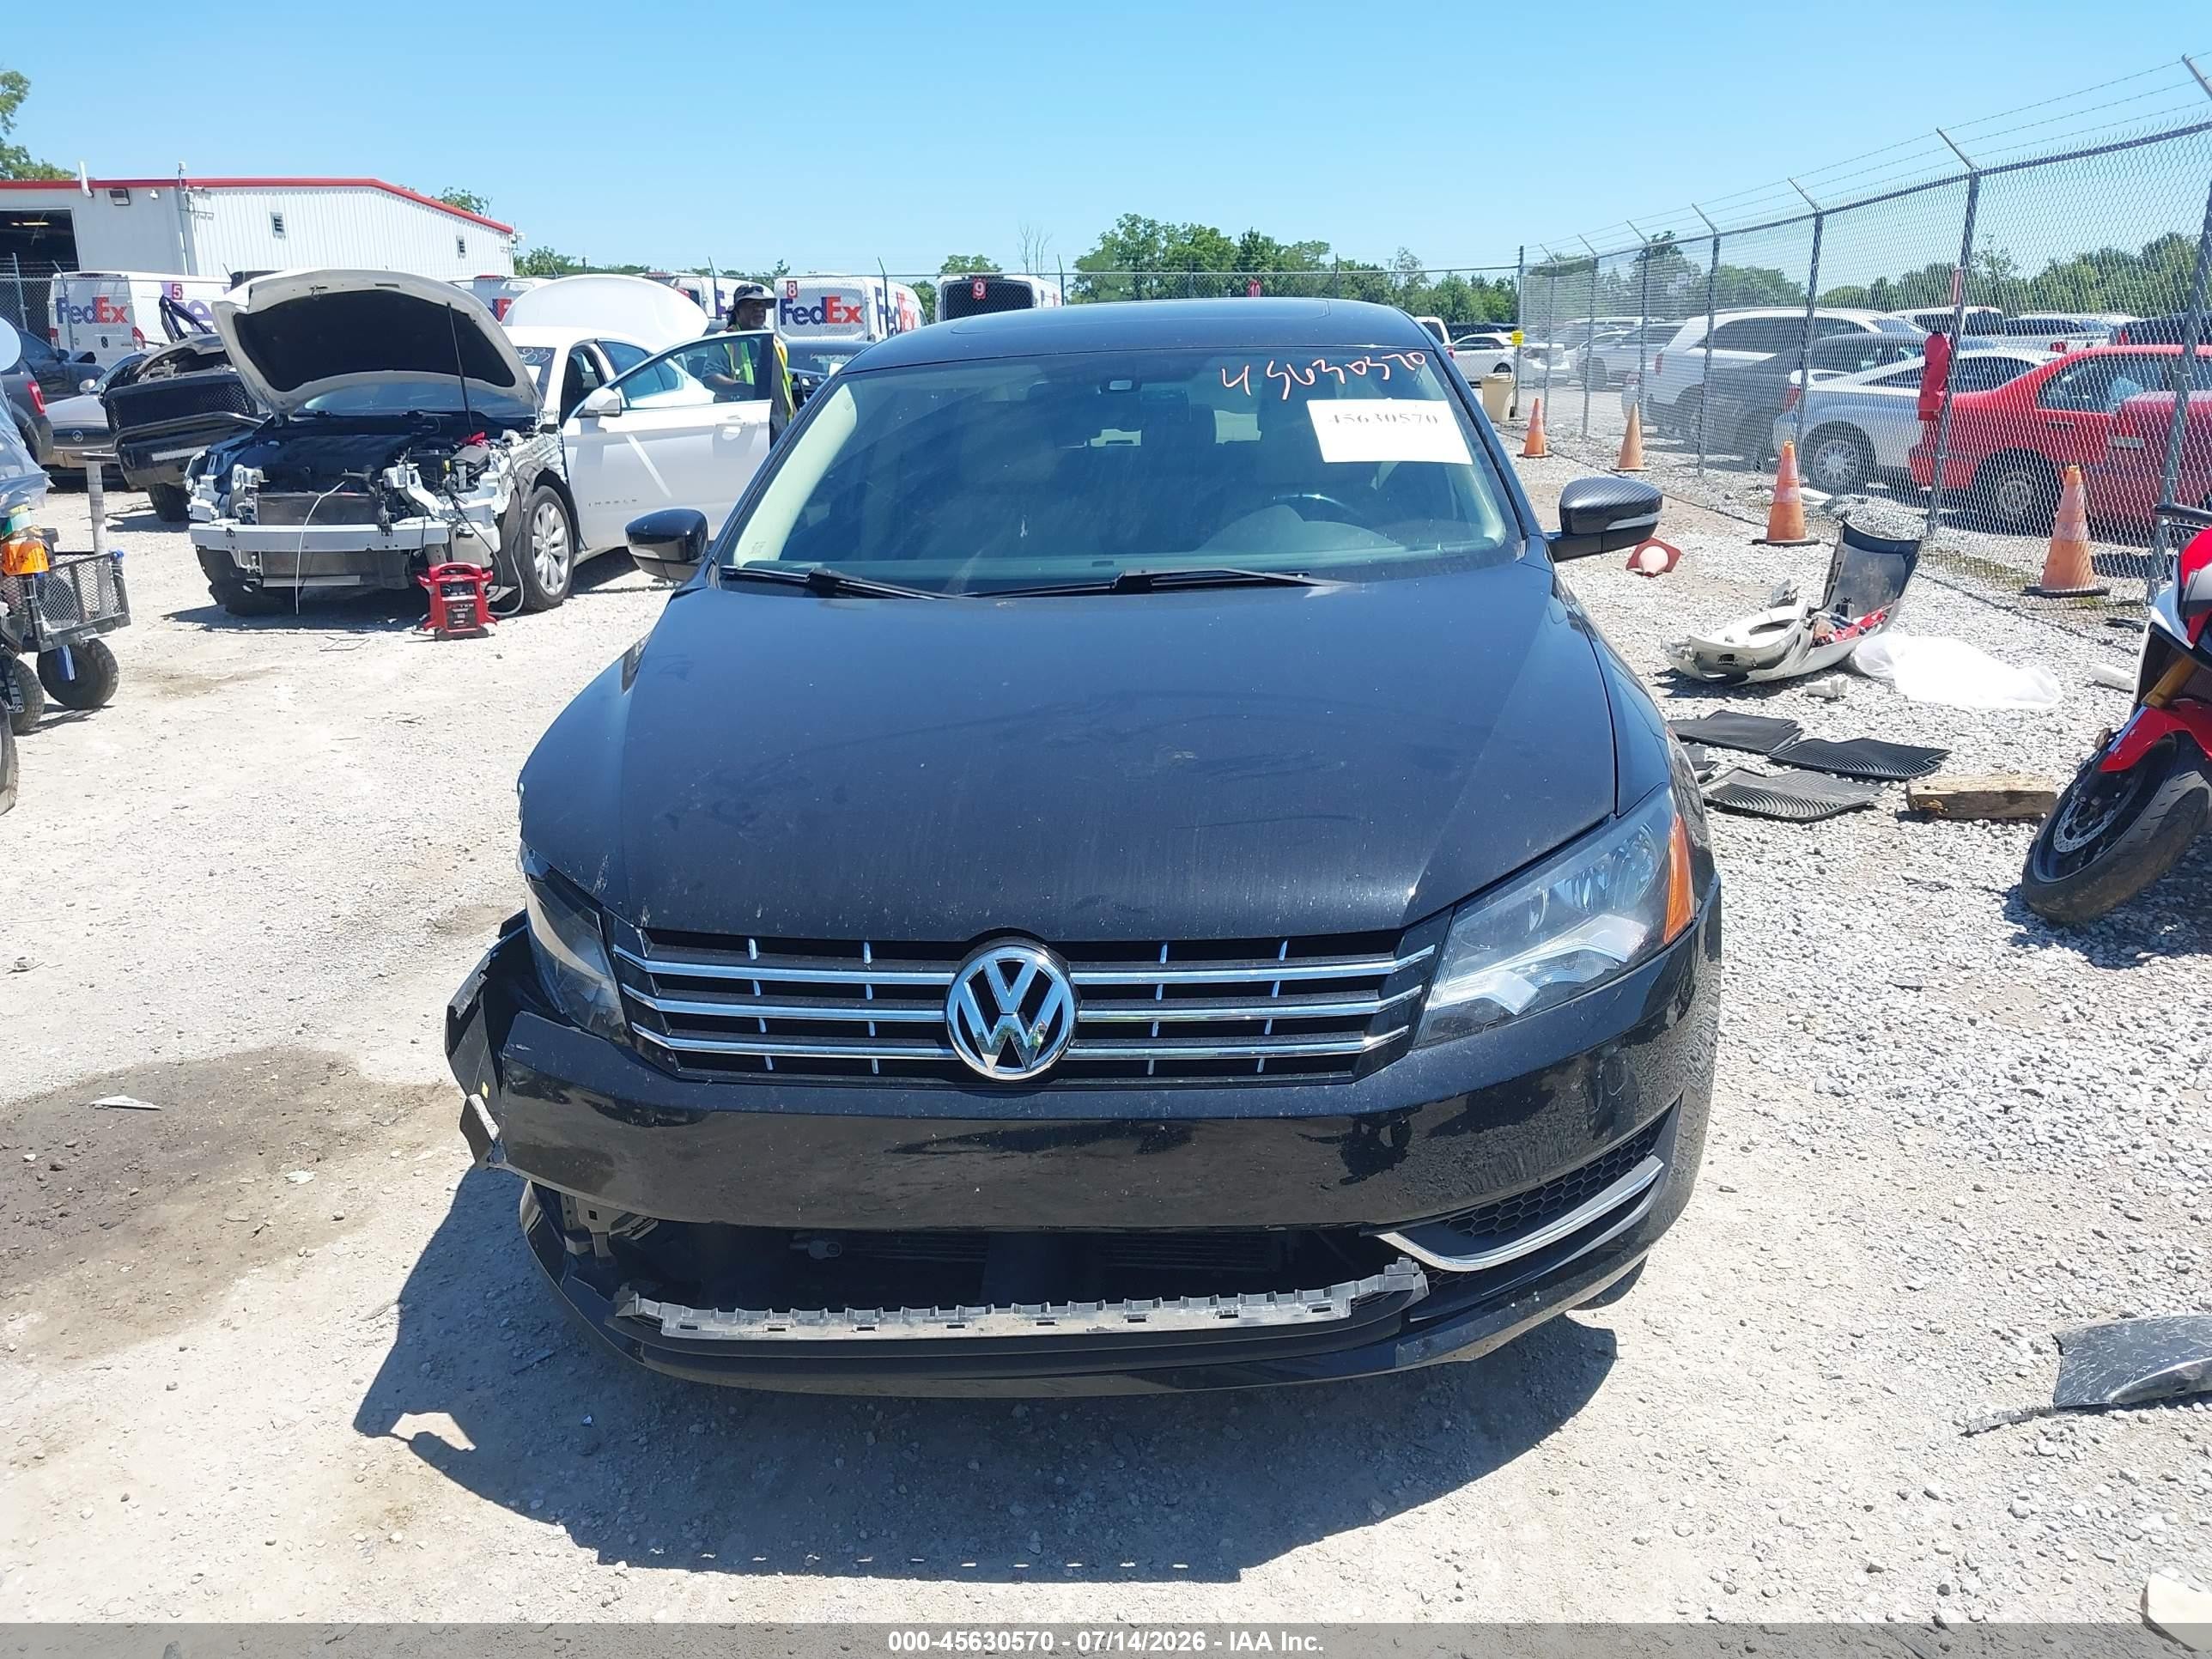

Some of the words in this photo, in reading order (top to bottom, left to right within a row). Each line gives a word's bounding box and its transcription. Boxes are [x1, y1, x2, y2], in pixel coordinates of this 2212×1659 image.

[173, 285, 182, 301] 5
[787, 282, 798, 297] 8
[975, 281, 986, 296] 9
[56, 296, 129, 325] FedEx
[779, 295, 865, 326] FedEx
